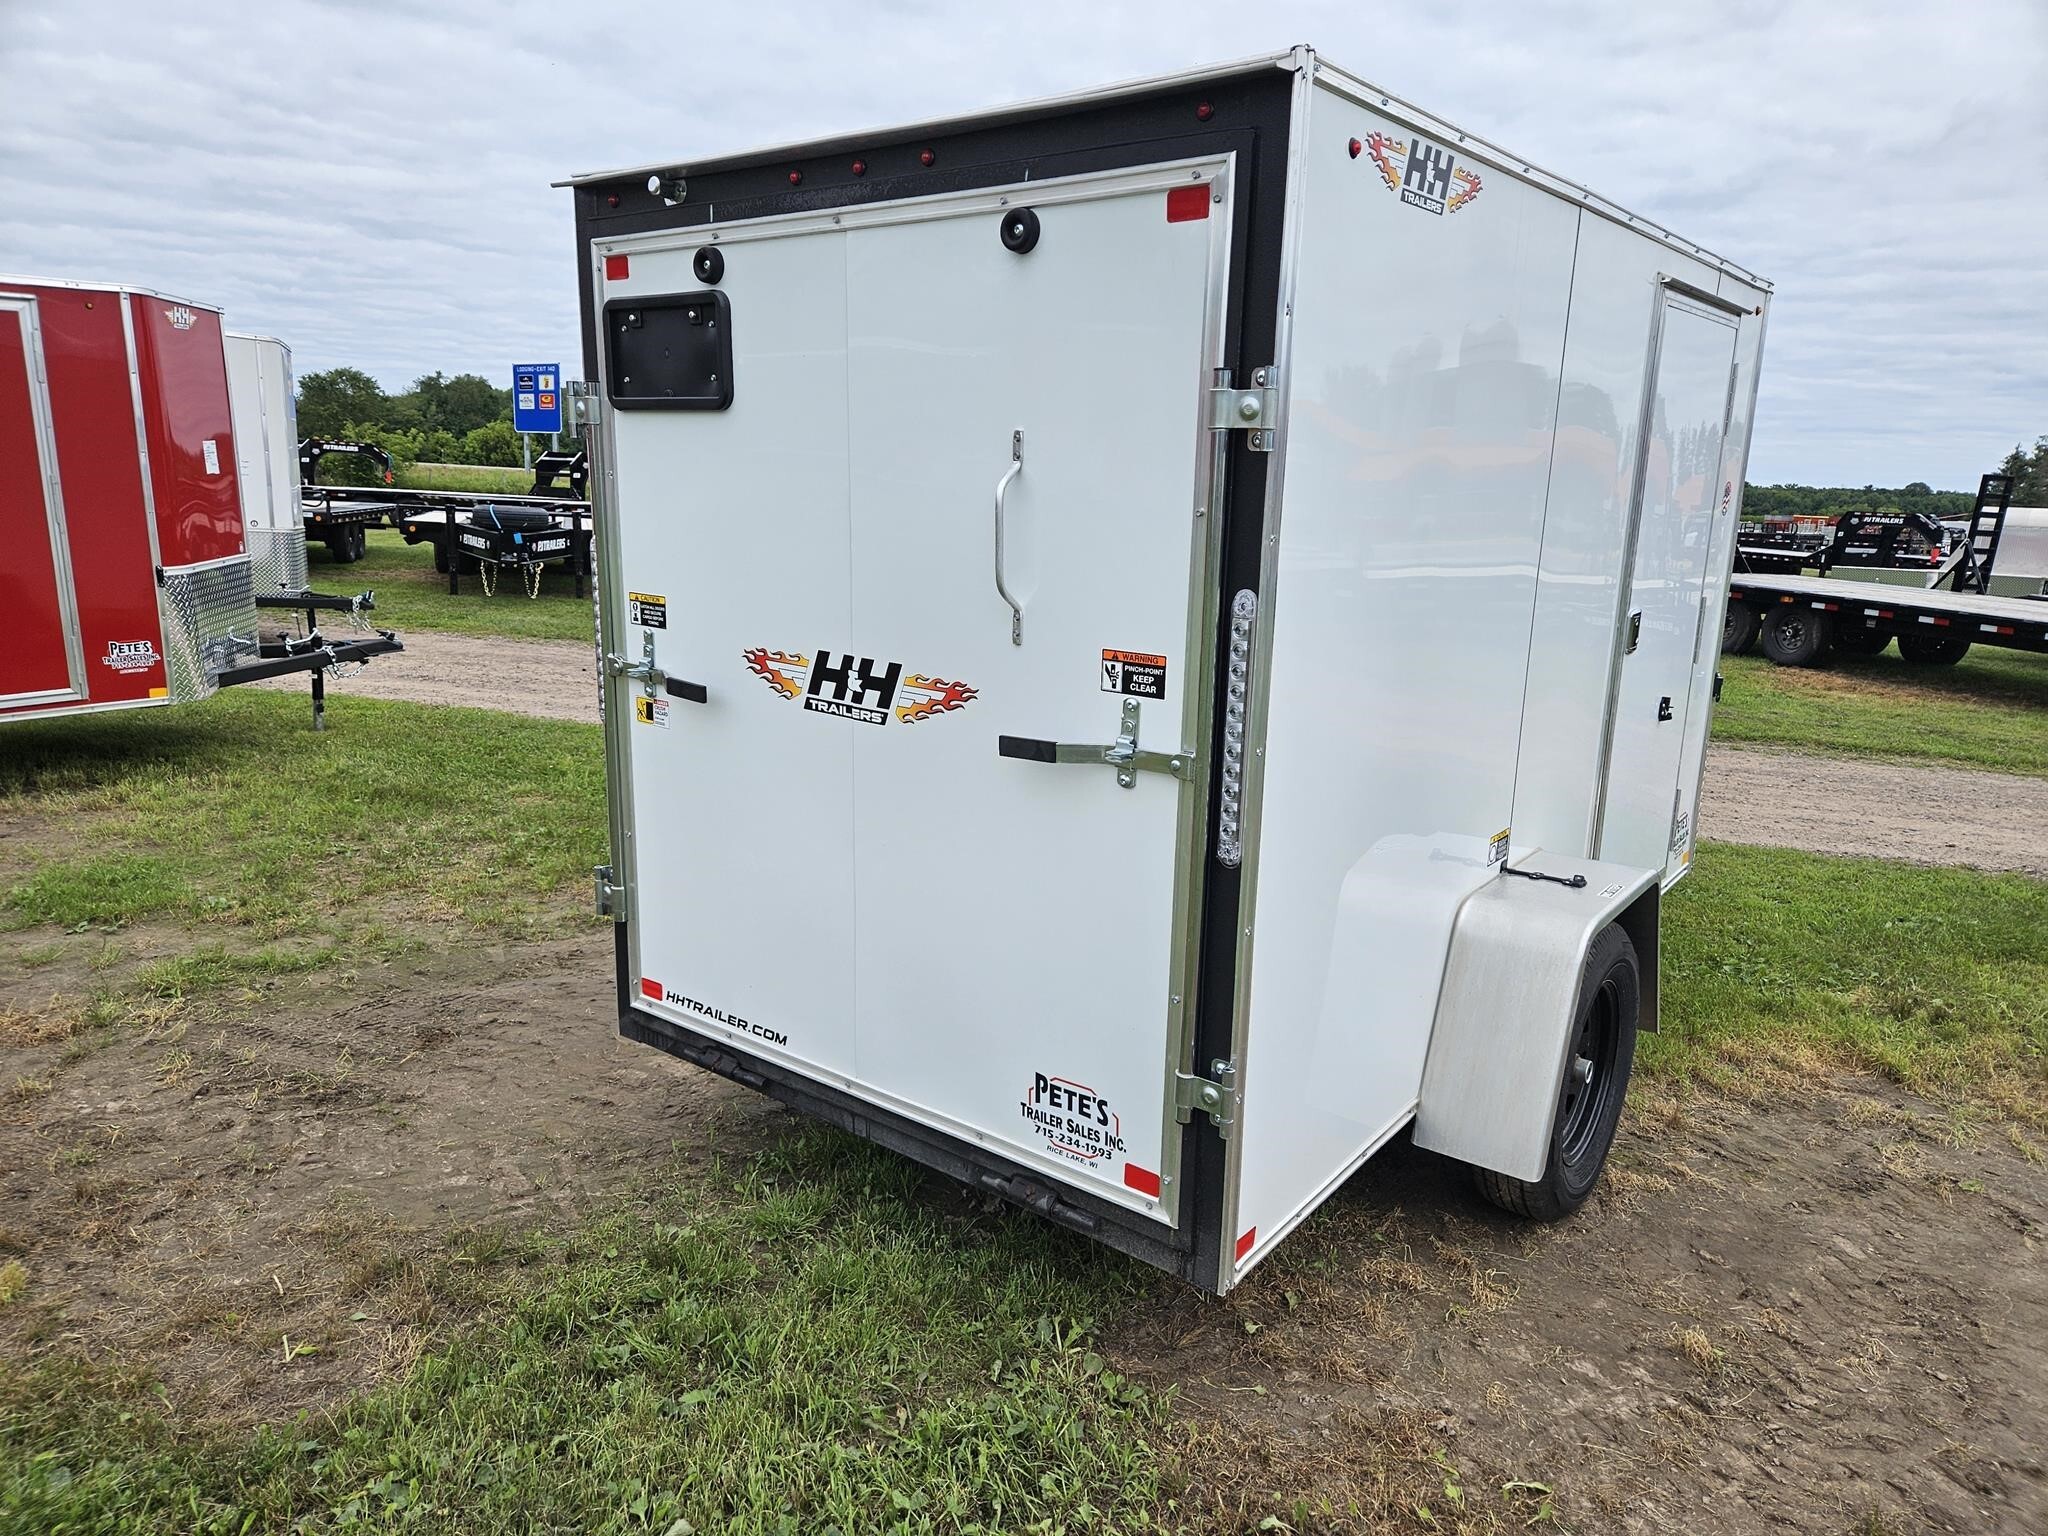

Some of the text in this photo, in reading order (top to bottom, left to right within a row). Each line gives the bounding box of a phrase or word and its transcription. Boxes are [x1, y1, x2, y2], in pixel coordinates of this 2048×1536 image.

[1403, 138, 1455, 201] H&H
[1403, 190, 1443, 214] TRAILERS
[640, 595, 660, 603] CAUTION
[109, 642, 150, 655] PETE'S
[128, 654, 147, 662] SALES
[1122, 653, 1159, 665] WARNING
[807, 650, 903, 710] H&H
[1124, 665, 1165, 676] PINCH-POINT
[1132, 674, 1155, 684] KEEP
[1129, 682, 1157, 694] CLEAR
[809, 699, 884, 723] TRAILERS
[666, 990, 788, 1047] HHTRAILER.COM
[1034, 1071, 1109, 1127] PETE'S
[1020, 1101, 1127, 1153] TRAILER SALES INC.
[1034, 1124, 1112, 1160] 715-234-1993
[1046, 1145, 1064, 1156] RICE
[1089, 1160, 1099, 1169] WI
